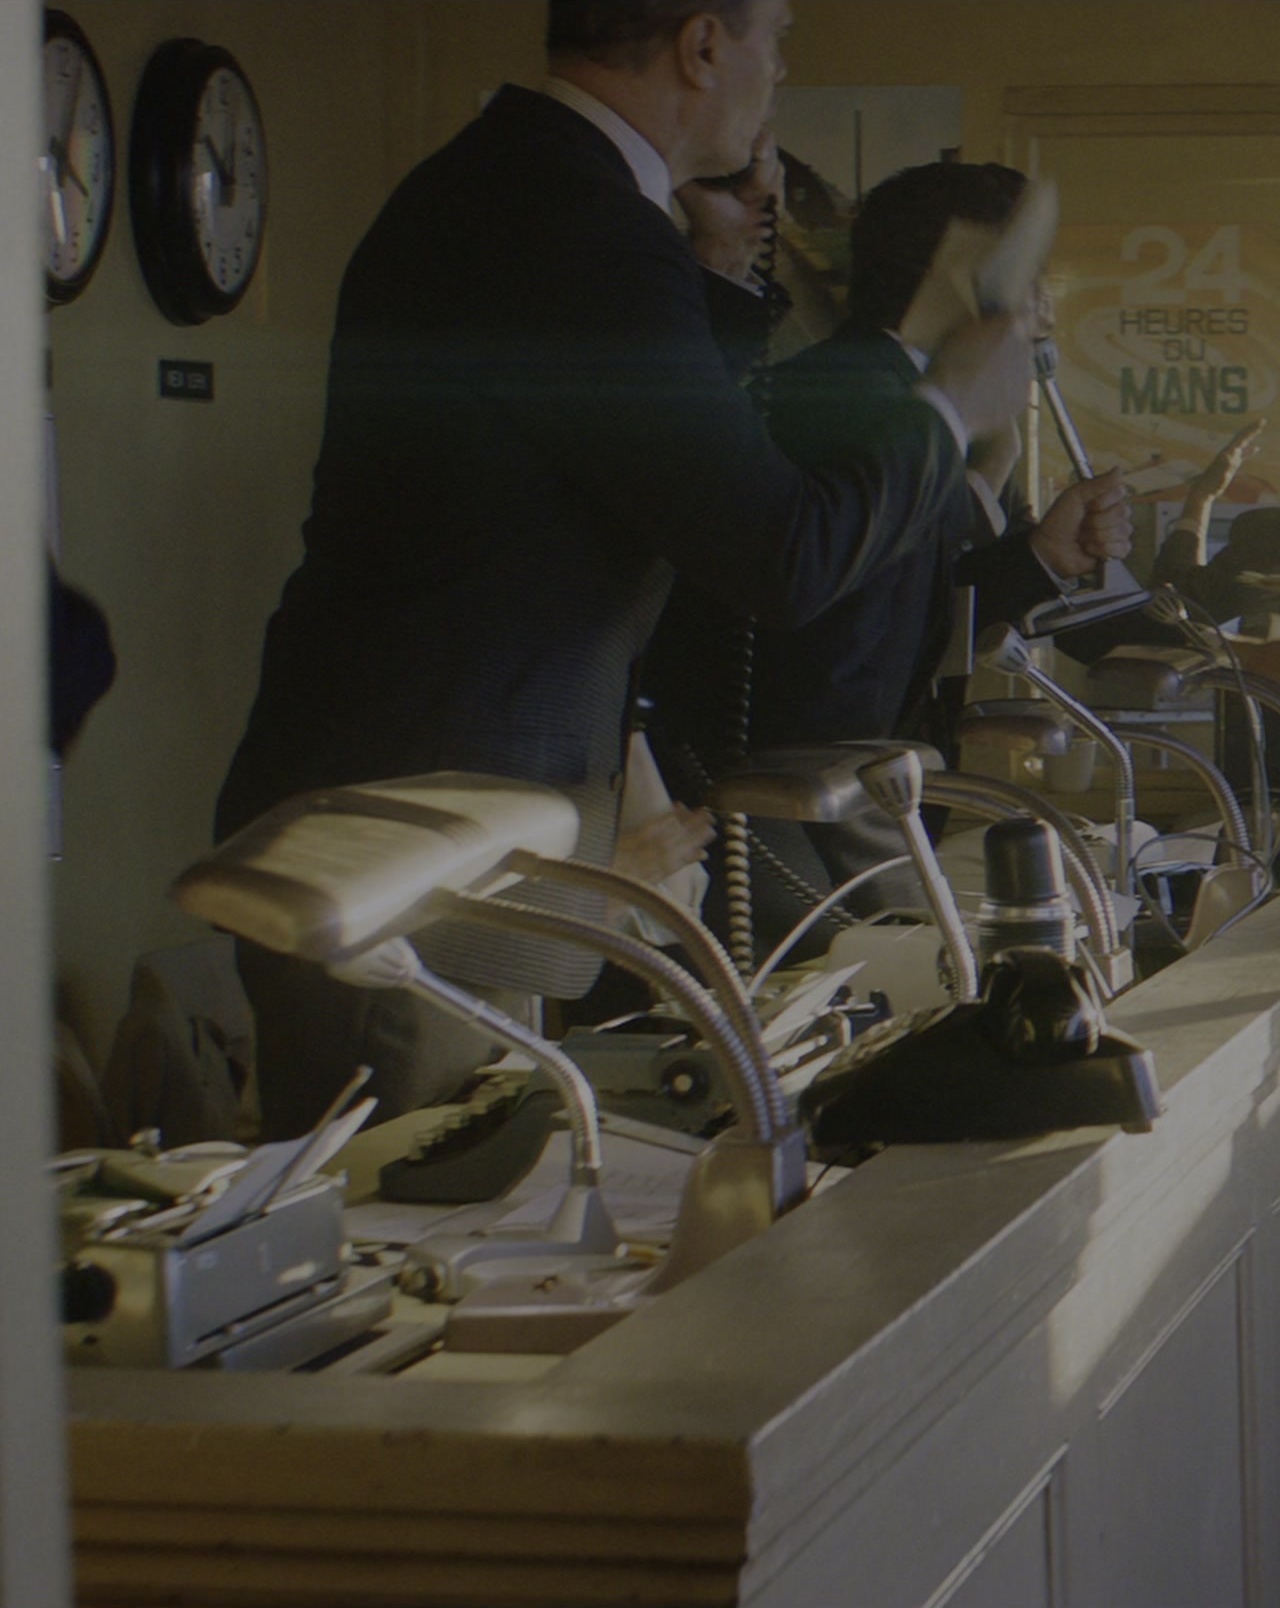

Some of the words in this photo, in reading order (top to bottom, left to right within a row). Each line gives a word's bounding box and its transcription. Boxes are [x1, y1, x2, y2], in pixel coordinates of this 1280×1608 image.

[1121, 224, 1241, 305] 24
[1120, 309, 1248, 335] HEURES
[1120, 367, 1248, 414] MANS
